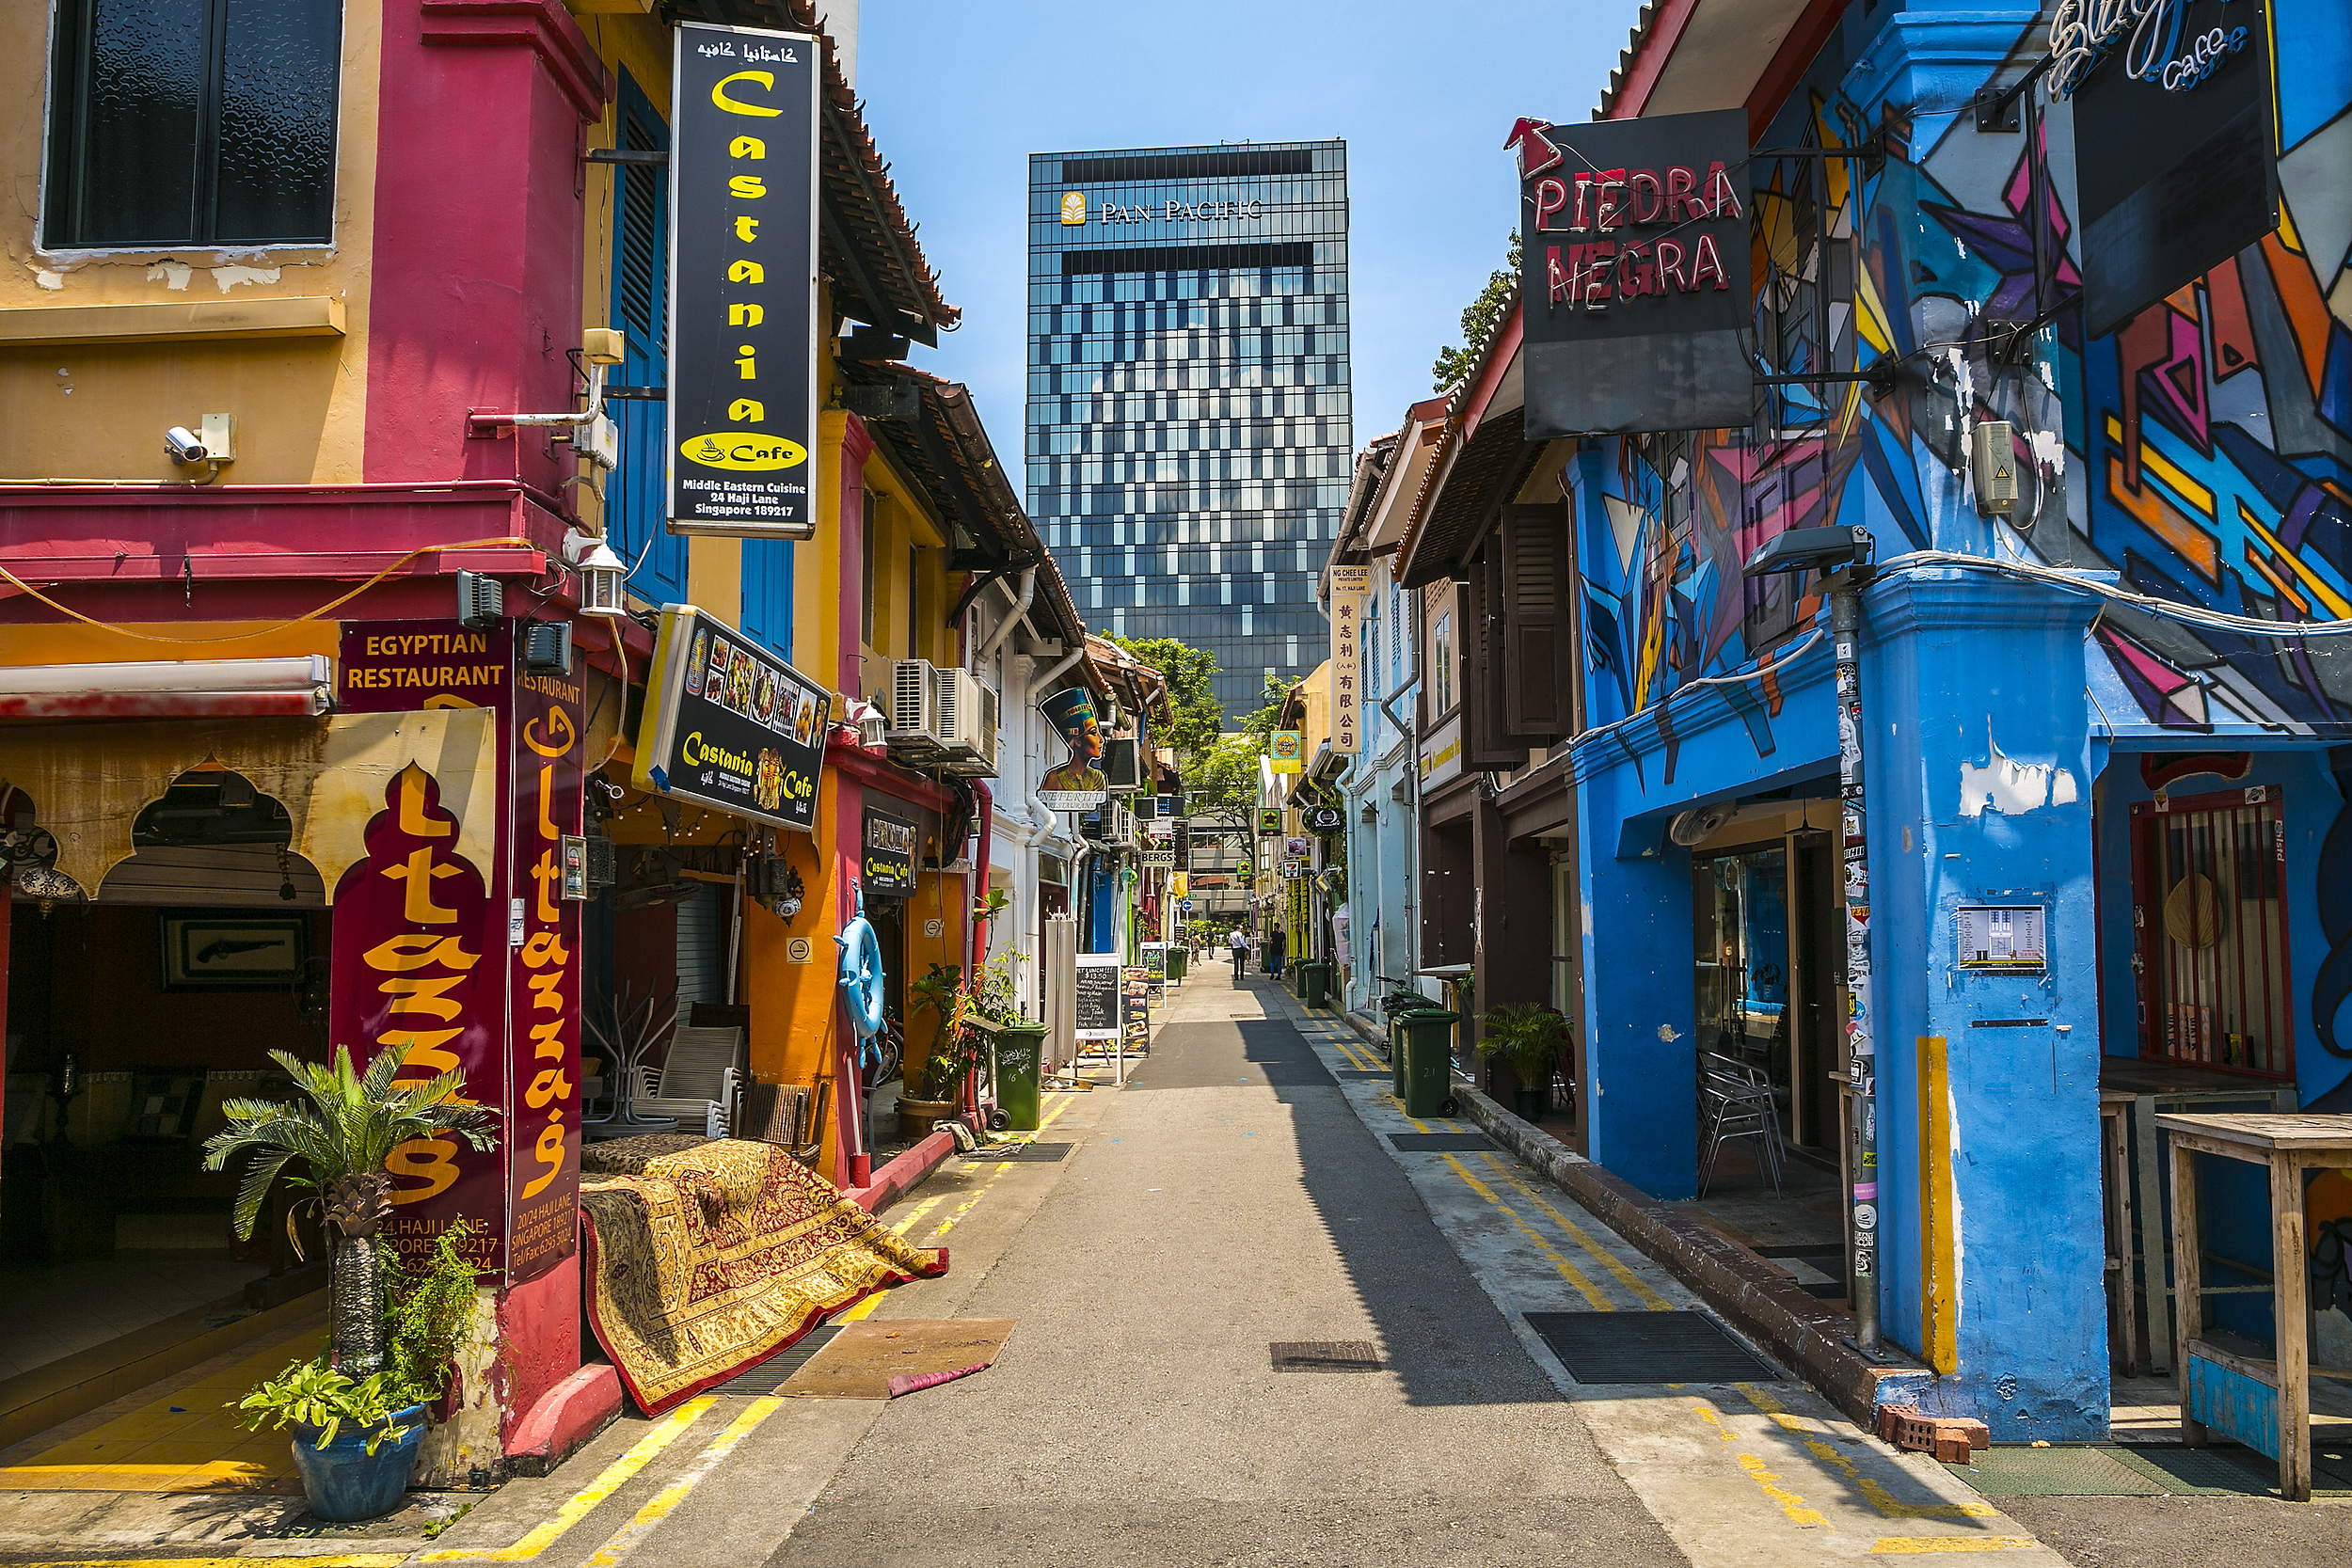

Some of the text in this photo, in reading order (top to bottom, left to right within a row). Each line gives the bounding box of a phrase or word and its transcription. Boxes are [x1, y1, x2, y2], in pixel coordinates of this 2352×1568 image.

[1534, 161, 1744, 234] PIEDRA
[1101, 199, 1263, 225] PAN PACIFIC
[711, 71, 784, 423] Castania
[1547, 233, 1729, 310] NEGRA
[730, 445, 793, 462] Cafe
[682, 479, 806, 494] Middle Eastern Cuisine
[695, 503, 794, 516] Singapore 189217
[710, 492, 779, 505] 24 Haji Lane
[1358, 568, 1368, 577] LEE
[366, 633, 487, 656] EGYPTIAN
[347, 664, 504, 688] RESTAURANT
[517, 670, 580, 705] RESTAURANT
[683, 731, 753, 777] Castania
[783, 770, 813, 800] Cafe
[1040, 791, 1104, 802] NEFERTITI
[866, 857, 908, 880] Castania Cafe
[1141, 853, 1173, 863] BERGS
[1008, 1072, 1017, 1083] 16
[516, 1208, 538, 1230] 20/24
[538, 1200, 554, 1220] HAJI
[400, 1219, 436, 1234] HAJI
[440, 1219, 488, 1236] LNE,
[511, 1207, 576, 1251] SINGAPORE 189217
[449, 1237, 499, 1254] 9217
[513, 1226, 572, 1268] Tel/Fax: 6295 5024
